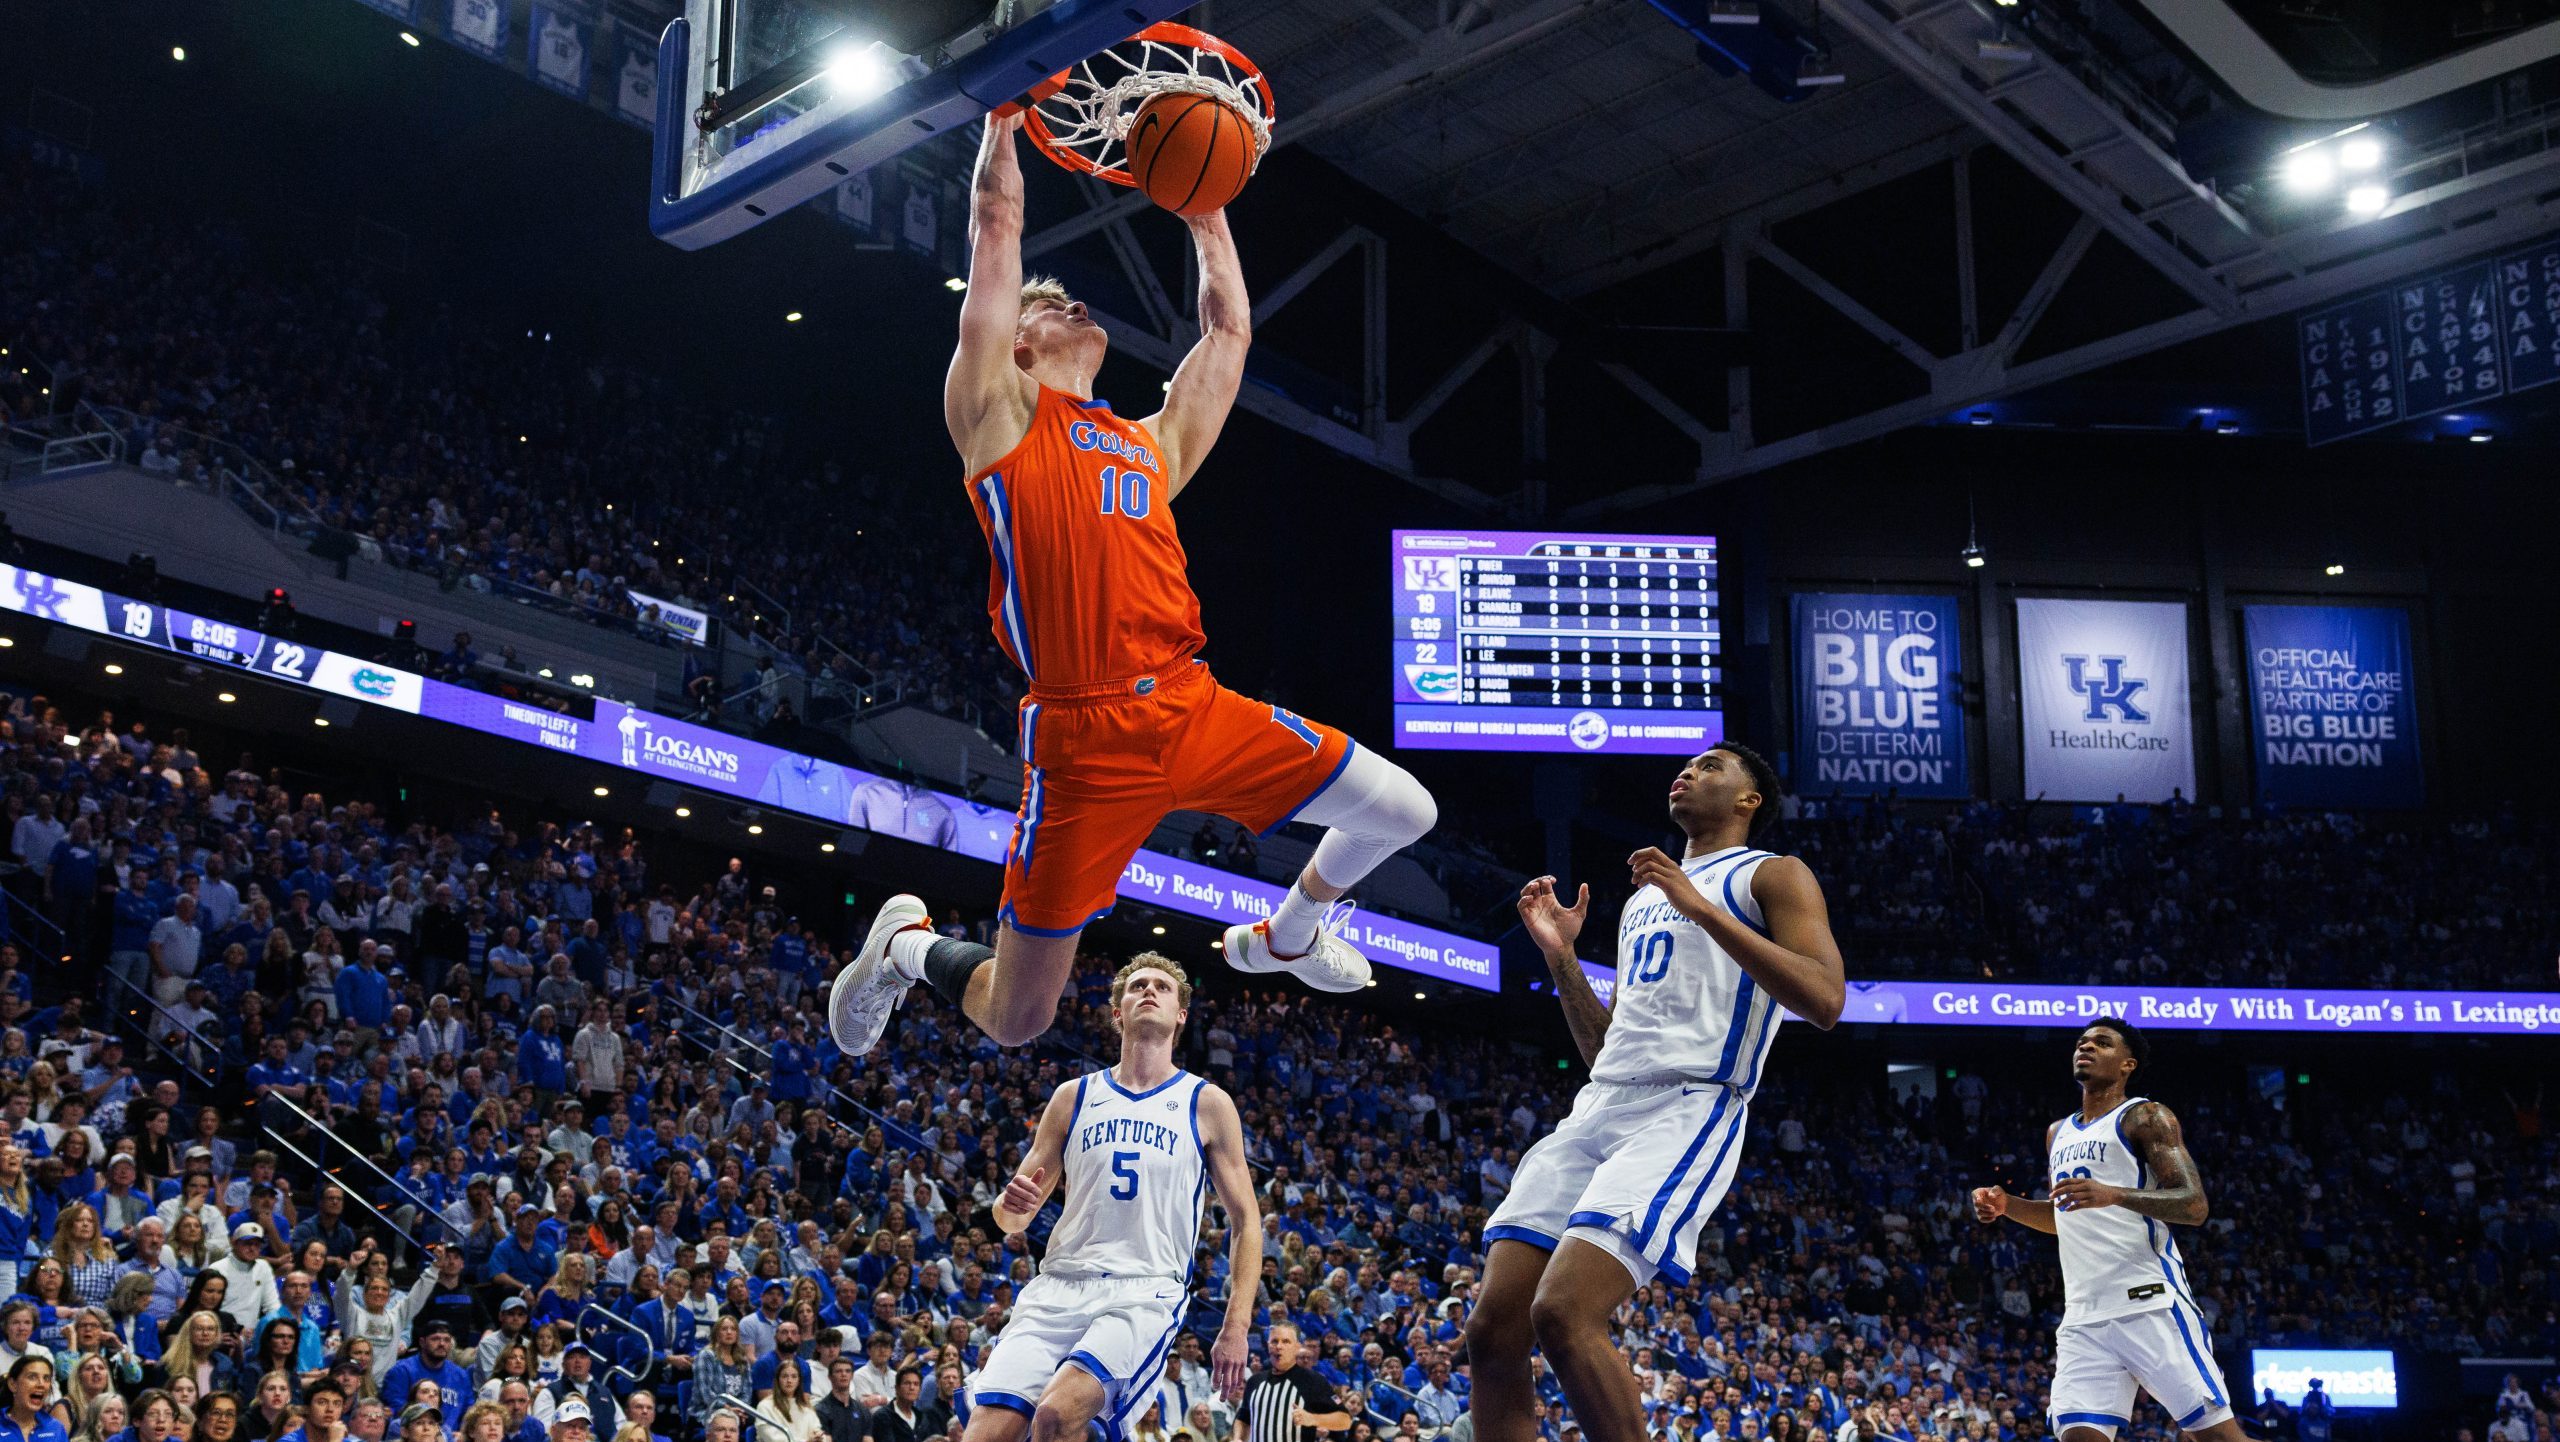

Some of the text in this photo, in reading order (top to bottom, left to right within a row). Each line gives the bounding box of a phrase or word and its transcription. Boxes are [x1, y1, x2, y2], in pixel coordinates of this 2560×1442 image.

[2506, 261, 2537, 356] NCAA
[2403, 287, 2430, 382] NCAA
[2438, 285, 2464, 394] CHAMPION
[2307, 319, 2333, 412] NCAA
[2369, 327, 2393, 417] 1942
[1070, 421, 1158, 473] Gators
[1100, 465, 1151, 519] 10
[1413, 560, 1449, 586] UK
[1463, 574, 1471, 585] 2
[1548, 562, 1558, 572] 11
[1580, 563, 1586, 573] 1
[1610, 563, 1616, 573] 1
[1699, 565, 1705, 576] 1
[14, 567, 71, 623] UK
[1416, 594, 1435, 613] 19
[1463, 588, 1471, 598] 4
[1550, 589, 1558, 601] 2
[1581, 590, 1587, 601] 1
[1611, 591, 1617, 602] 1
[1700, 593, 1706, 604] 1
[123, 604, 153, 638] 19
[1410, 617, 1441, 631] 8:05
[1550, 617, 1558, 628] 2
[1582, 618, 1588, 628] 1
[1701, 621, 1707, 631] 1
[1813, 609, 1936, 632] HOME TO
[190, 619, 238, 650] 8:05
[1612, 639, 1618, 649] 1
[271, 642, 306, 678] 22
[1416, 643, 1437, 663] 22
[1466, 650, 1471, 660] 1
[1479, 650, 1495, 661] LEE
[1612, 653, 1619, 664] 2
[1814, 633, 1938, 689] BIG
[2258, 648, 2357, 669] OFFICIAL
[1582, 666, 1590, 677] 2
[1644, 668, 1650, 678] 1
[2261, 670, 2402, 691] HEALTHCARE
[1552, 680, 1559, 690] 7
[1704, 683, 1709, 693] 1
[2062, 653, 2150, 724] UK
[1552, 693, 1560, 704] 2
[1704, 697, 1710, 707] 1
[1816, 690, 1940, 728] BLUE
[2263, 691, 2395, 712] PARTNER OF
[503, 704, 548, 730] TIMEOUTS
[1405, 720, 1452, 733] KENTUCKY
[1480, 722, 1515, 734] BUREAU
[1517, 723, 1566, 735] INSURANCE
[1644, 726, 1704, 738] COMMITMENT
[2265, 714, 2396, 739] BIG BLUE
[643, 731, 738, 773] LOGAN'S
[1817, 732, 1941, 756] DETERMI
[2050, 729, 2169, 751] HealthCare
[643, 752, 737, 783] AT LEXINGTON GREEN
[2266, 742, 2383, 767] NATION
[1173, 874, 1271, 918] Ready With
[1344, 921, 1490, 976] in Lexington Green!
[1627, 930, 1674, 985] 10
[1932, 992, 1979, 1014] Get
[1991, 993, 2128, 1019] Game-Day
[2140, 996, 2218, 1025] Ready
[2230, 998, 2294, 1019] With
[2304, 998, 2404, 1027] Logan's
[2414, 1000, 2442, 1021] in
[1082, 1119, 1178, 1155] KENTUCKY
[1109, 1151, 1140, 1200] 5
